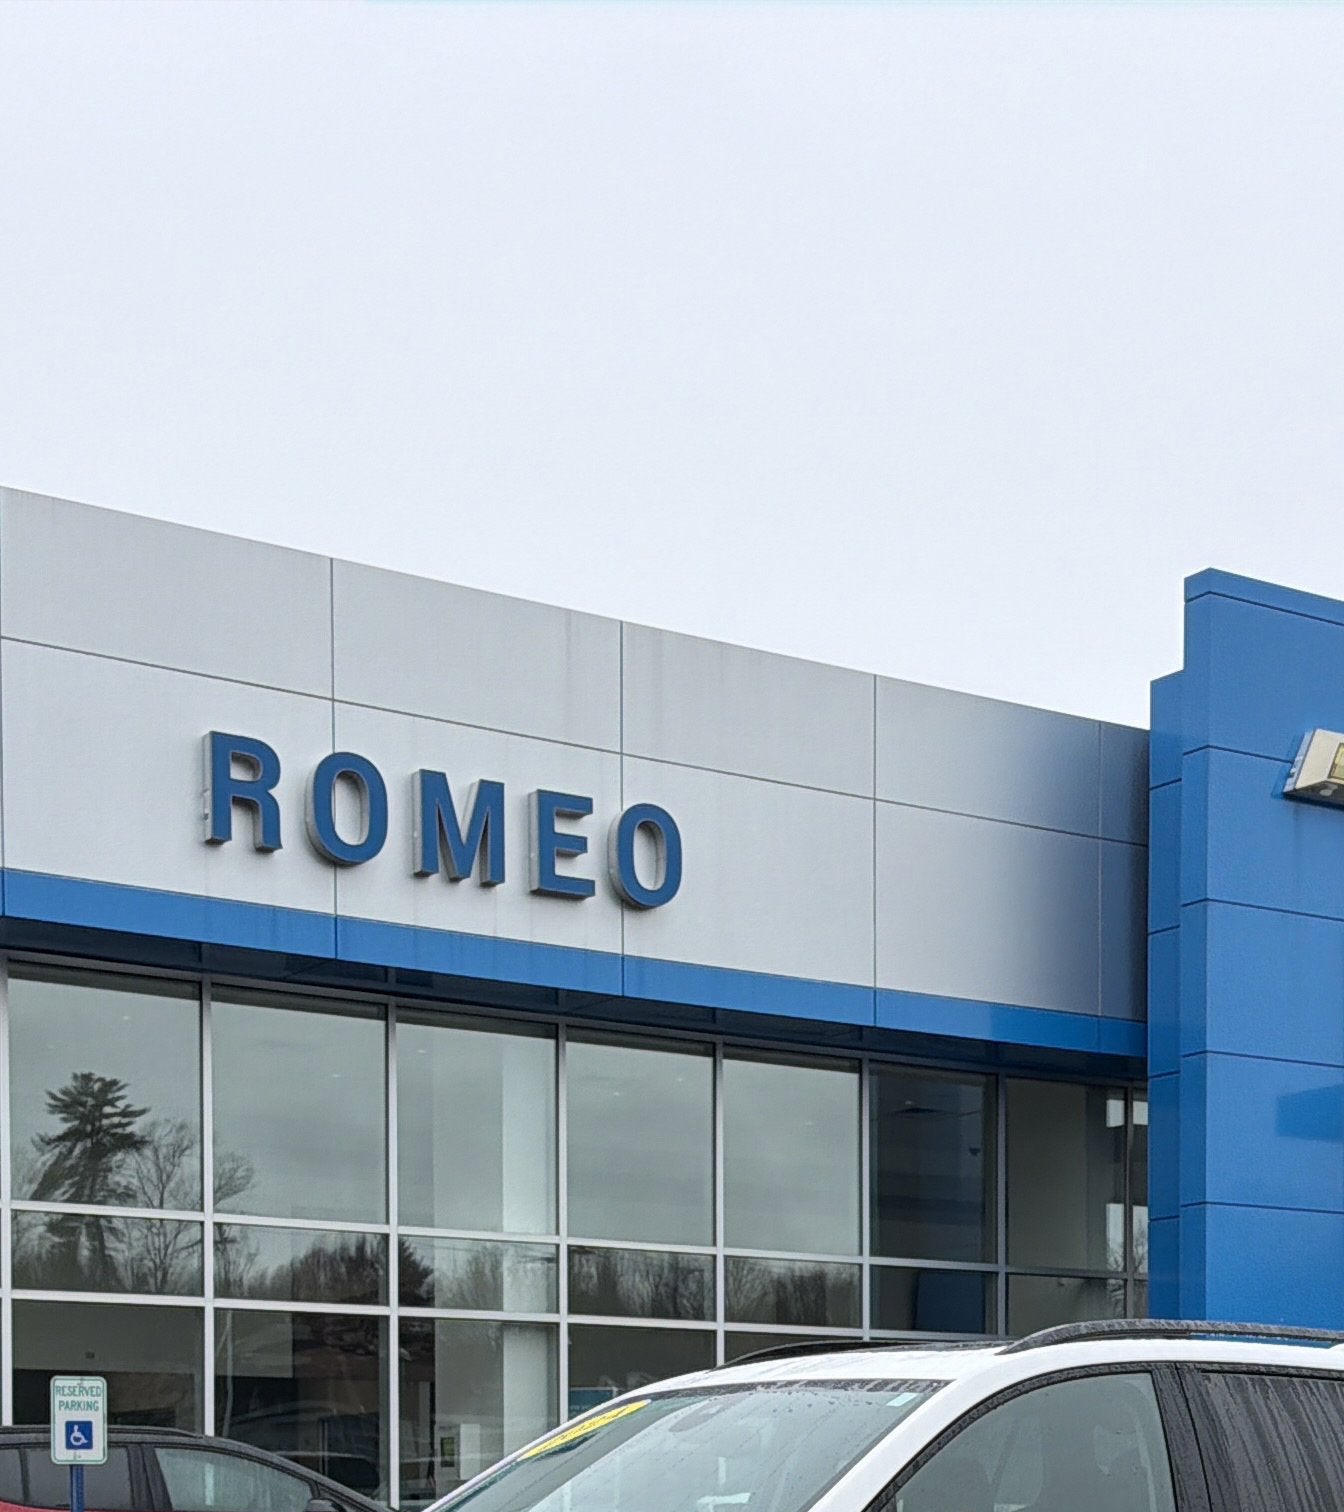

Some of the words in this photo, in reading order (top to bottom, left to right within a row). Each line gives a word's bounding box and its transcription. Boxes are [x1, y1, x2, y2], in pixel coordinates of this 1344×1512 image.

[202, 731, 682, 909] ROMEO
[55, 1385, 102, 1397] RESERVED
[58, 1400, 99, 1412] PARKING
